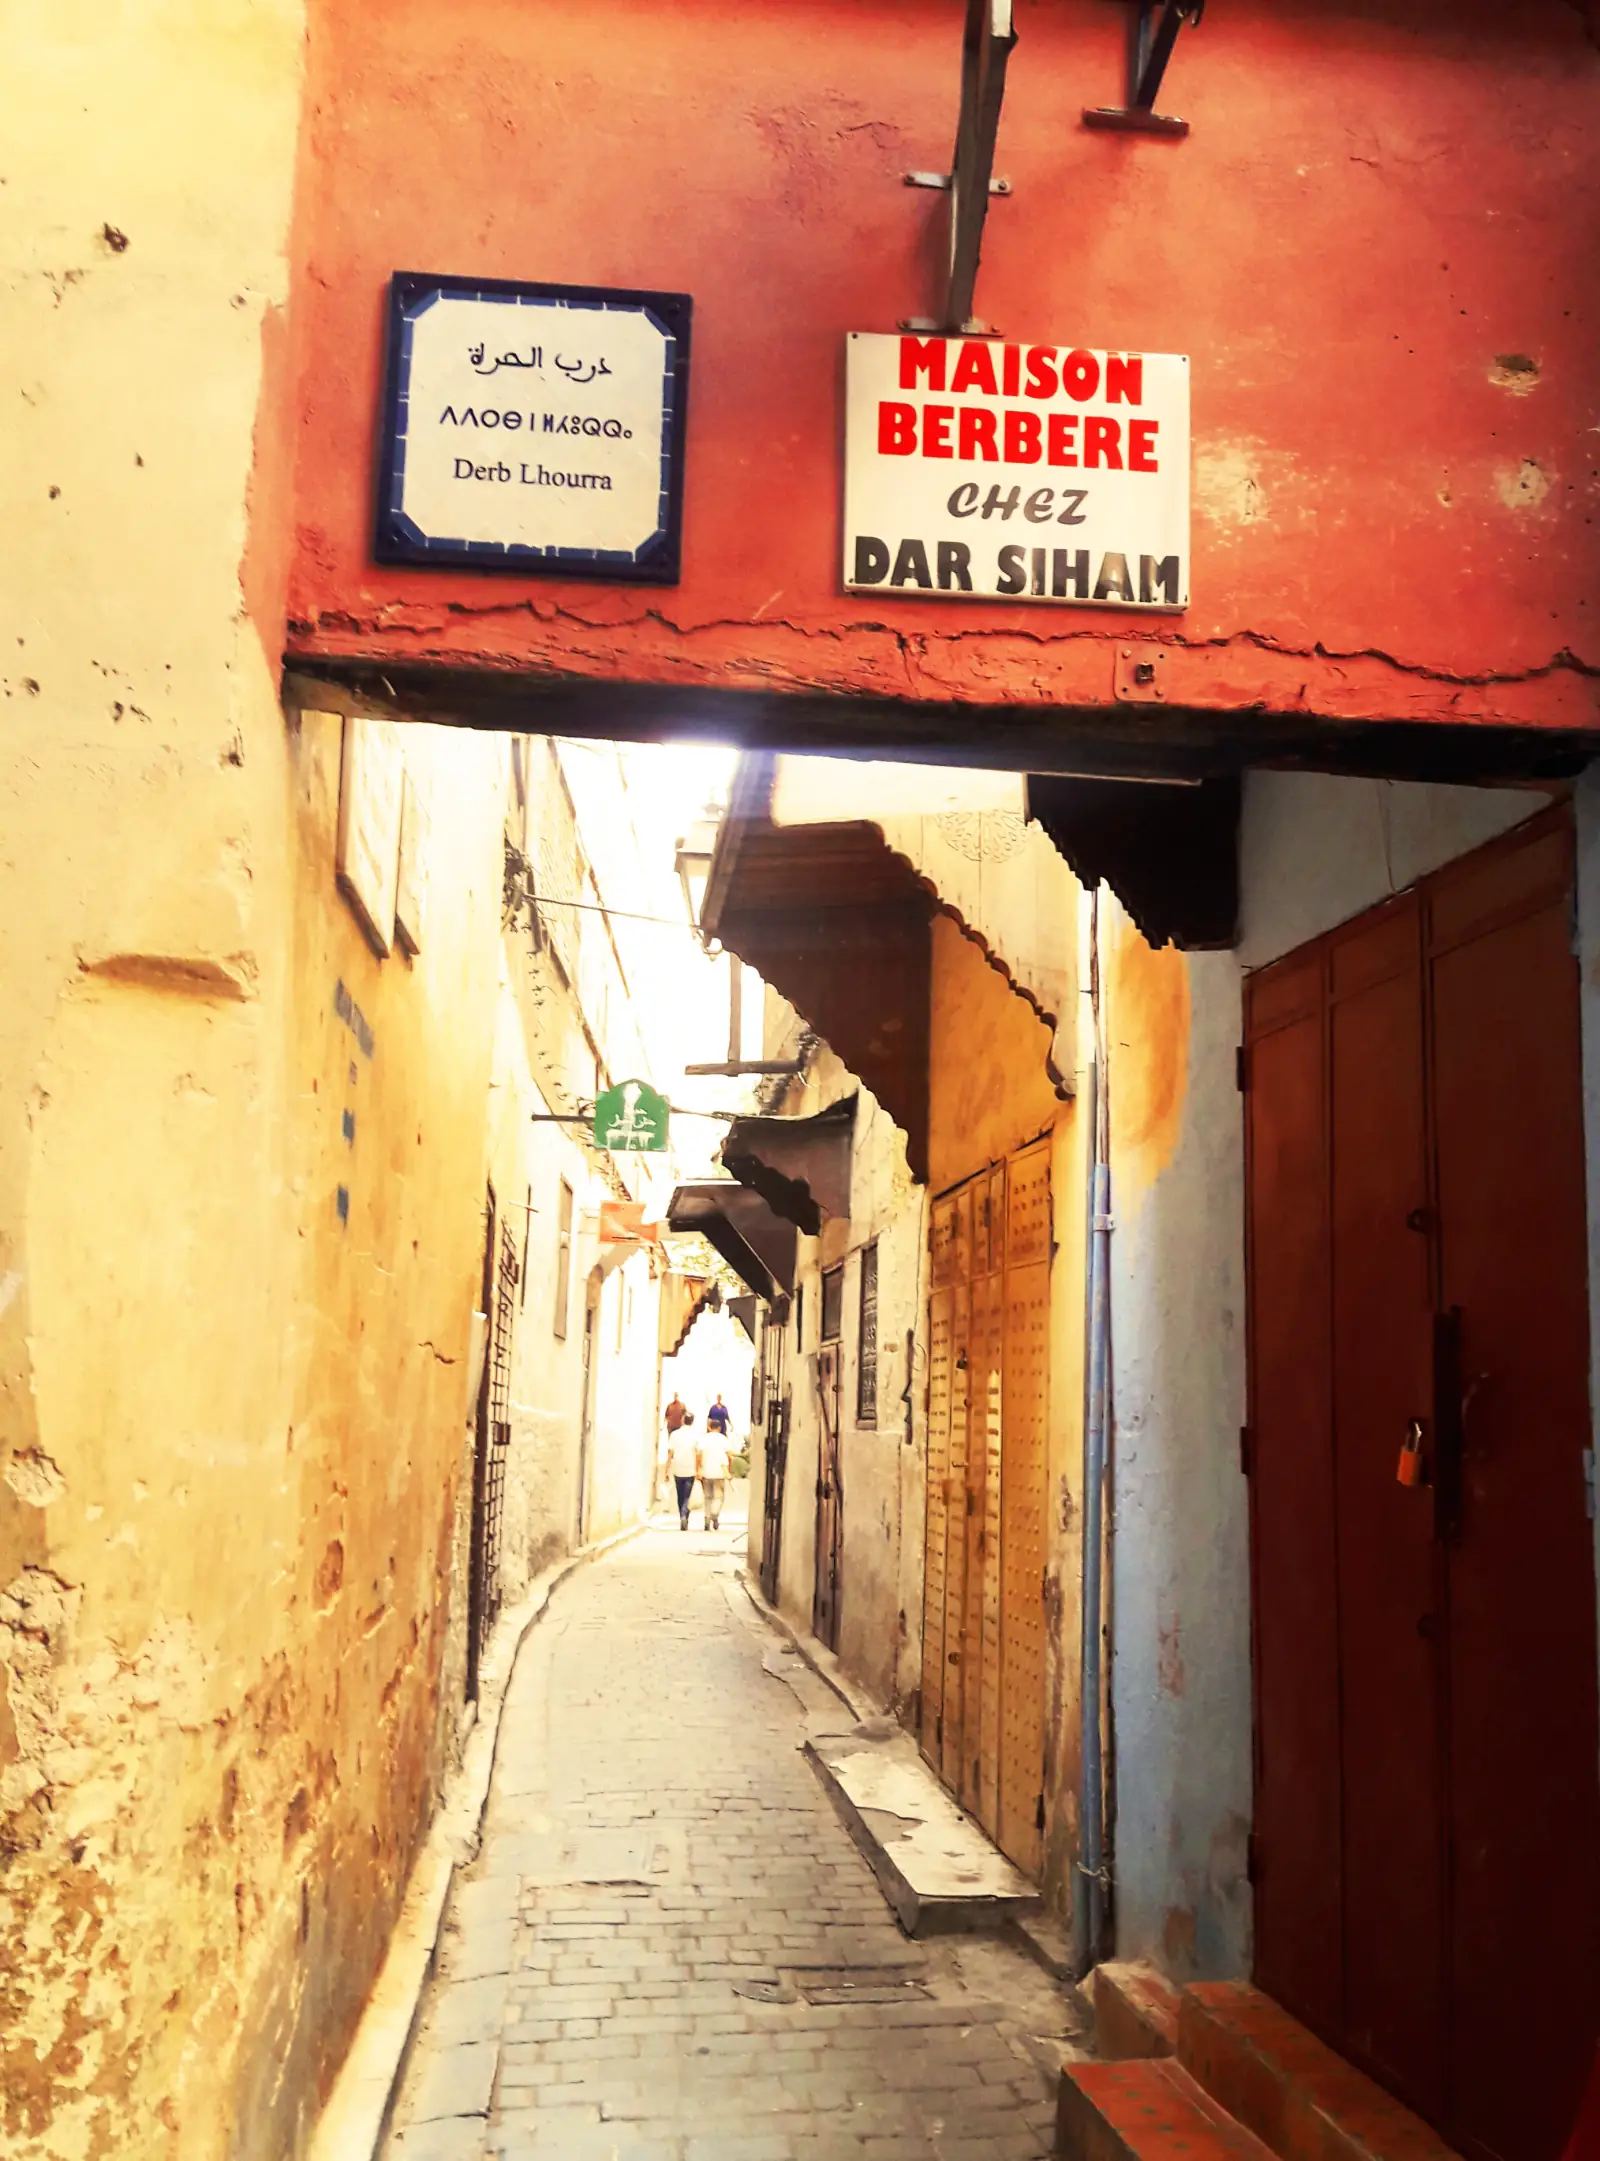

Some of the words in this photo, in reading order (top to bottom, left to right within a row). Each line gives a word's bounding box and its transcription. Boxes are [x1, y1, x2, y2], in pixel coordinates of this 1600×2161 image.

[467, 341, 543, 376] الحرة
[554, 352, 613, 384] درب
[898, 336, 1144, 406] MAISON
[877, 401, 1160, 473] BERBERE
[453, 457, 512, 483] Derb
[519, 463, 613, 491] Lhourra
[946, 482, 1090, 526] CHEZ
[853, 535, 974, 592] DAR
[995, 544, 1181, 605] SIHAM
